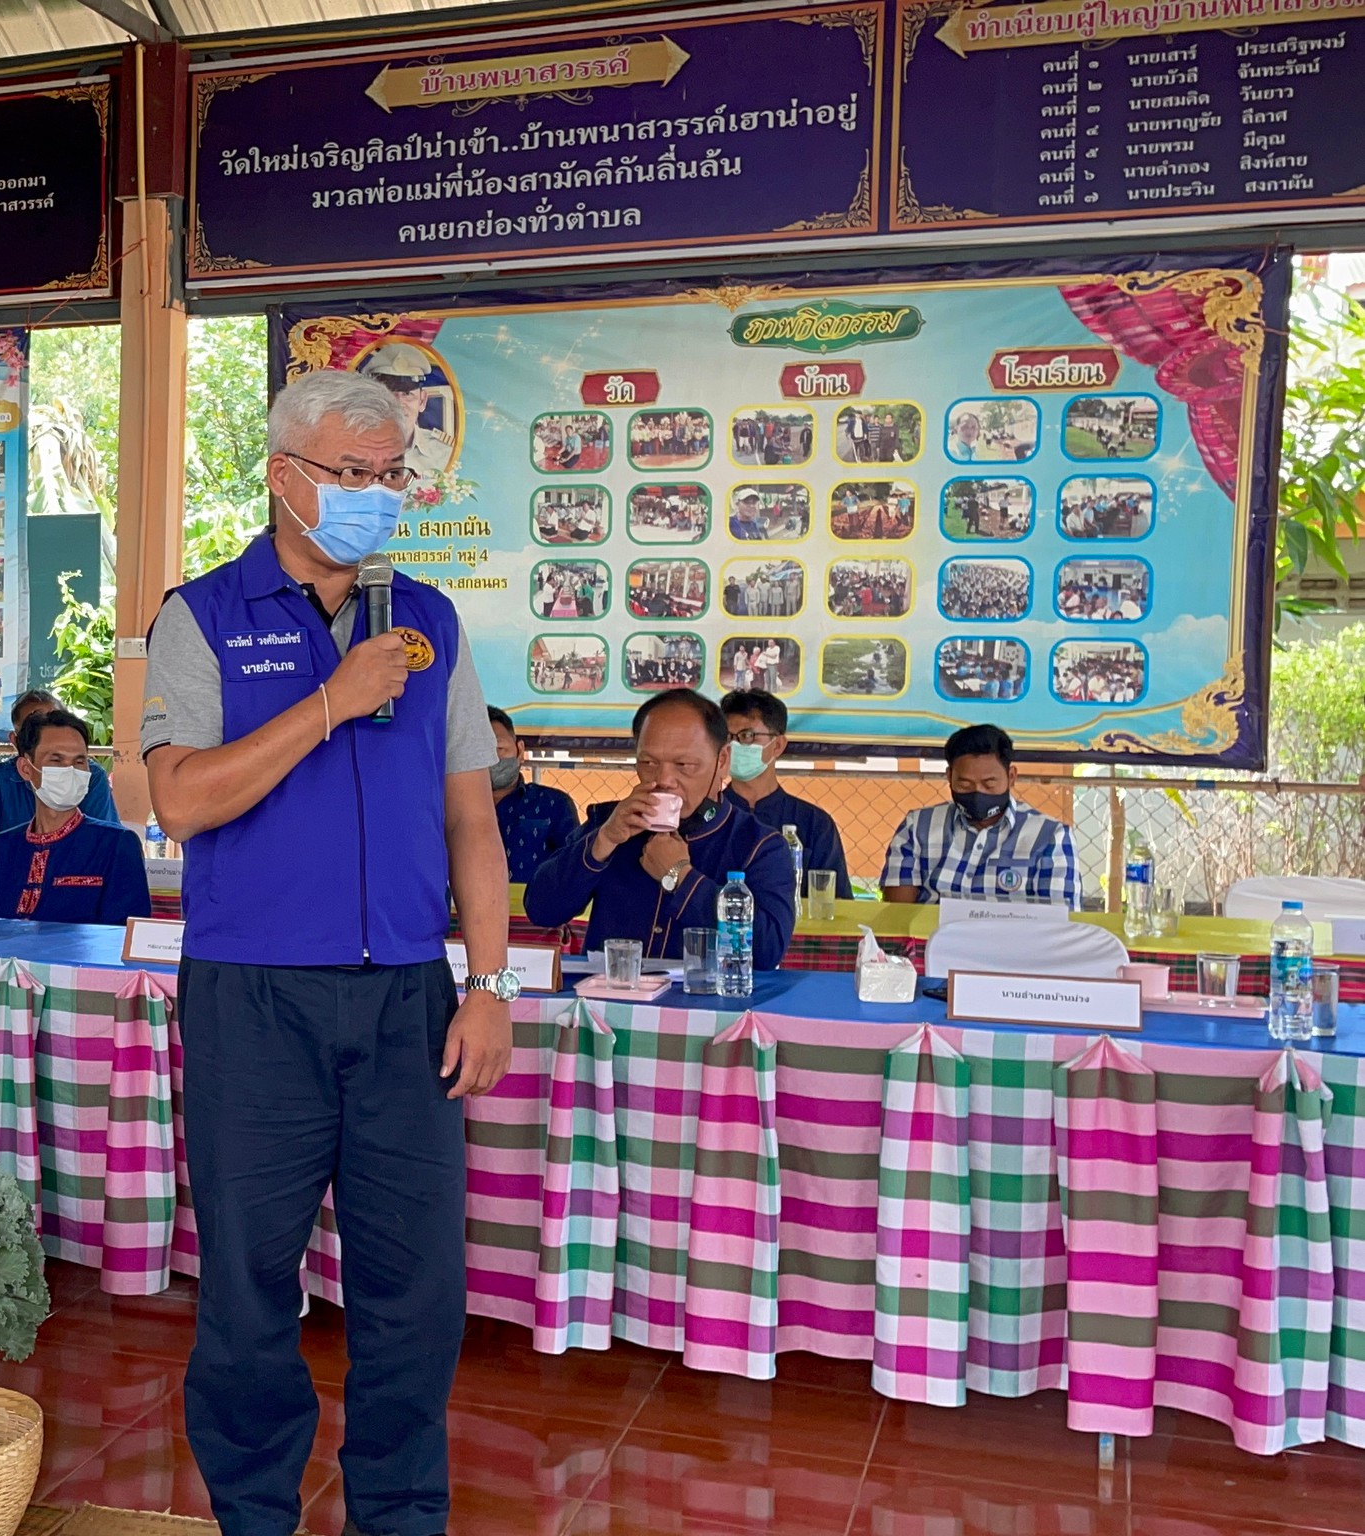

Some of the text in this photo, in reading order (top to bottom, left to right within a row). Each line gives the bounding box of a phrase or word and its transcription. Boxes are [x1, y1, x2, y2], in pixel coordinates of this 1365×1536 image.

[1043, 32, 1346, 72] คนที่ ๑ นายเสาร์ ประเสริฐพงษ์
[420, 47, 630, 96] บ้านพนาสวรรค์
[1042, 73, 1077, 95] คนที่
[1088, 80, 1102, 91] ๒
[1237, 57, 1320, 79] จันทะรัตน์
[1041, 85, 1294, 117] คนที่ ๓ นายสมคิด วันยาว
[1040, 118, 1076, 139] คนที่
[1086, 125, 1099, 136] ๔
[1040, 131, 1285, 161] คนที่ ๕ นายพรม มีคุณ
[312, 144, 741, 209] มวลพ่อแม่พี่น้องสามัคคีกันลื่นล้น
[1039, 153, 1307, 183] คนที่ ๖ นายคำกอง สิงห์สาย
[1038, 174, 1313, 206] คนที่ ๗ นายประวิน สงกาผัน
[399, 197, 641, 243] คนยกย่องทั่วตำบล
[743, 306, 912, 345] ภาพกิจกรรม
[795, 367, 850, 398] บ้าน
[1001, 352, 1105, 387] โรงเรียน
[602, 375, 635, 404] วัด
[420, 515, 491, 538] สงกาผัน
[457, 545, 476, 568] หมู่
[479, 549, 488, 562] 4
[446, 577, 508, 589] จ.สกลนคร
[241, 659, 295, 675] นายอำเภอ
[1002, 989, 1090, 1003] นายอำเภอบ้านม่วง
